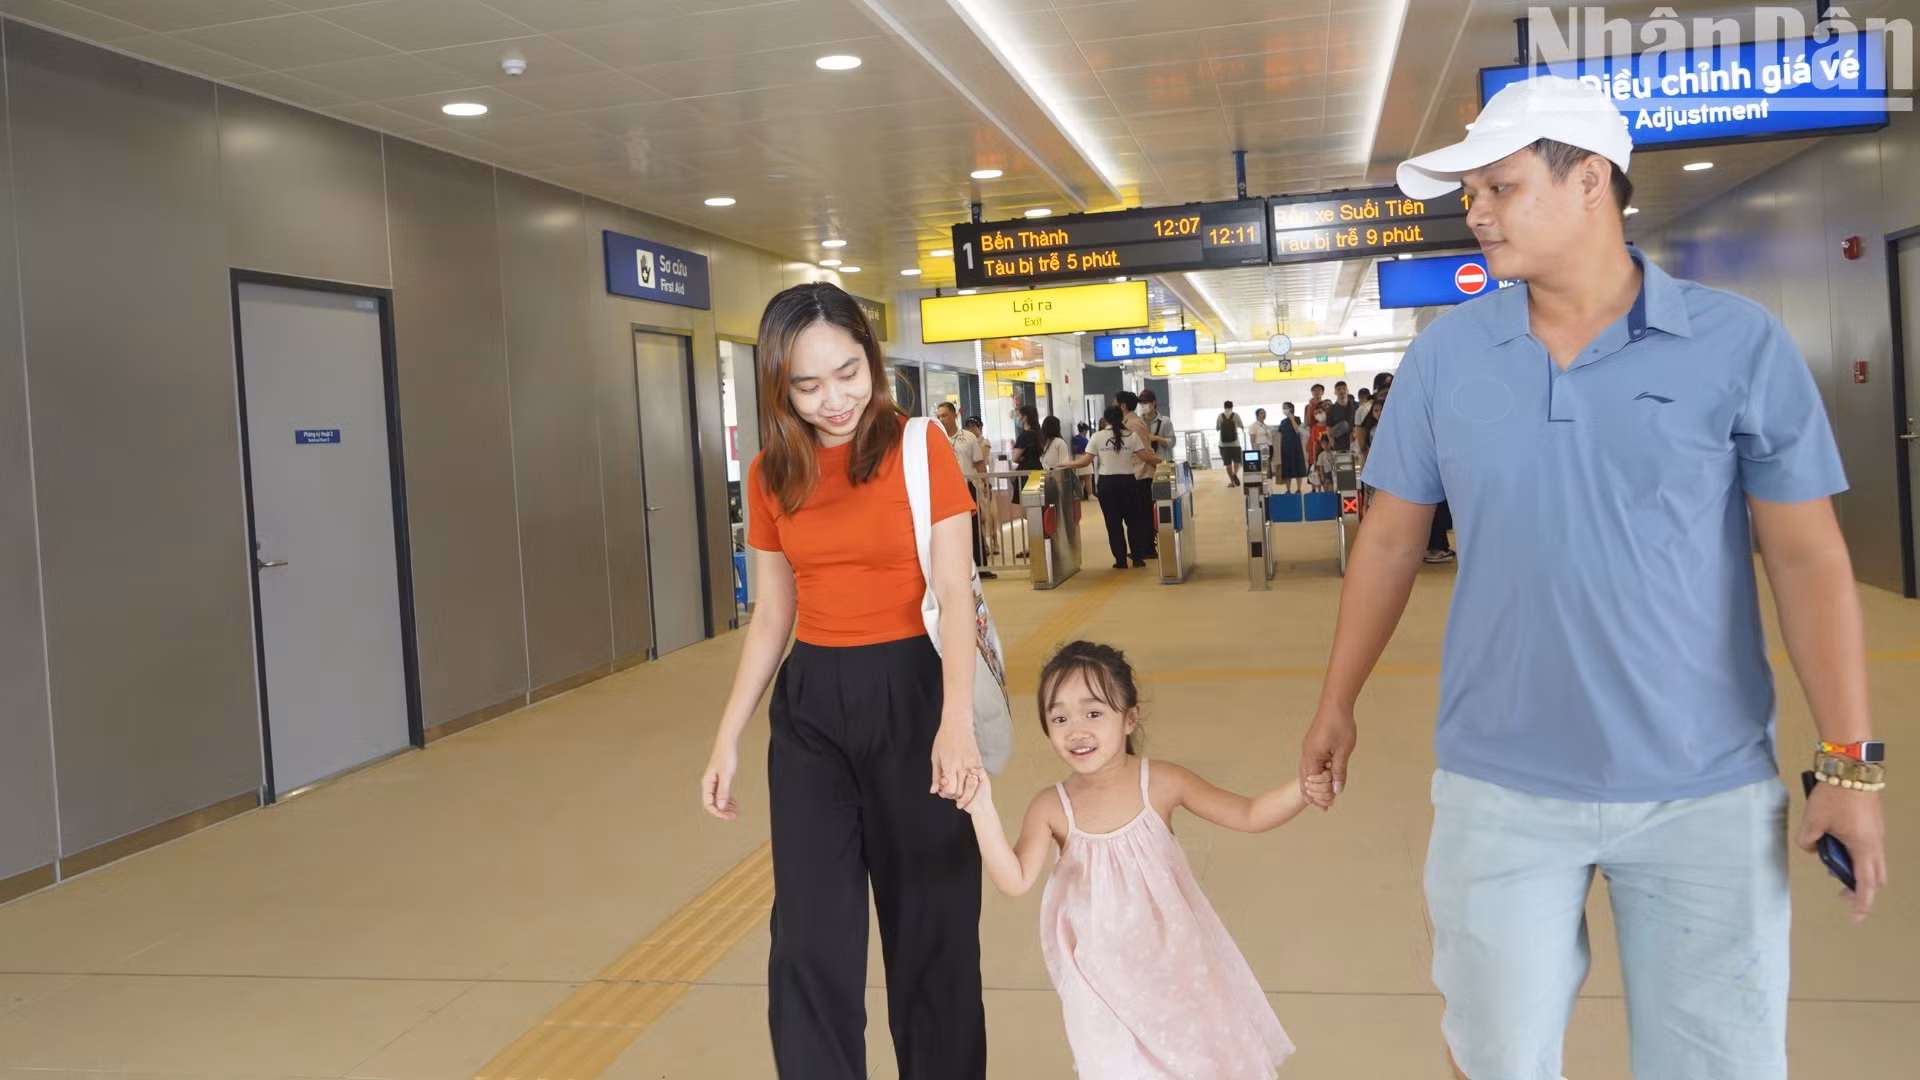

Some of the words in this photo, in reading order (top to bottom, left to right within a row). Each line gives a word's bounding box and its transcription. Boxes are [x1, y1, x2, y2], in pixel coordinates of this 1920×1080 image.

[1661, 61, 1751, 96] chỉnh
[1761, 54, 1811, 94] giá
[1819, 49, 1860, 81] vé
[1635, 98, 1769, 132] Adjustment
[1315, 208, 1334, 222] xe
[1340, 199, 1380, 221] Suối
[1385, 199, 1424, 217] Tiên
[981, 231, 1014, 252] Bến
[1018, 229, 1068, 247] Thành
[1154, 216, 1200, 237] 12:07
[1209, 225, 1255, 245] 12:11
[1315, 233, 1330, 251] bị
[1336, 227, 1359, 248] trễ
[1366, 229, 1378, 245] 9
[1383, 225, 1424, 246] phút.
[962, 242, 974, 269] 1
[983, 258, 1015, 276] Tàu
[1019, 257, 1034, 275] bị
[1038, 252, 1060, 272] trễ
[1067, 253, 1078, 269] 5
[1082, 250, 1121, 271] phút.
[660, 278, 674, 292] First
[675, 281, 685, 295] Aid
[1013, 297, 1034, 313] Lối
[1037, 300, 1052, 312] ra
[1024, 317, 1043, 327] Exit
